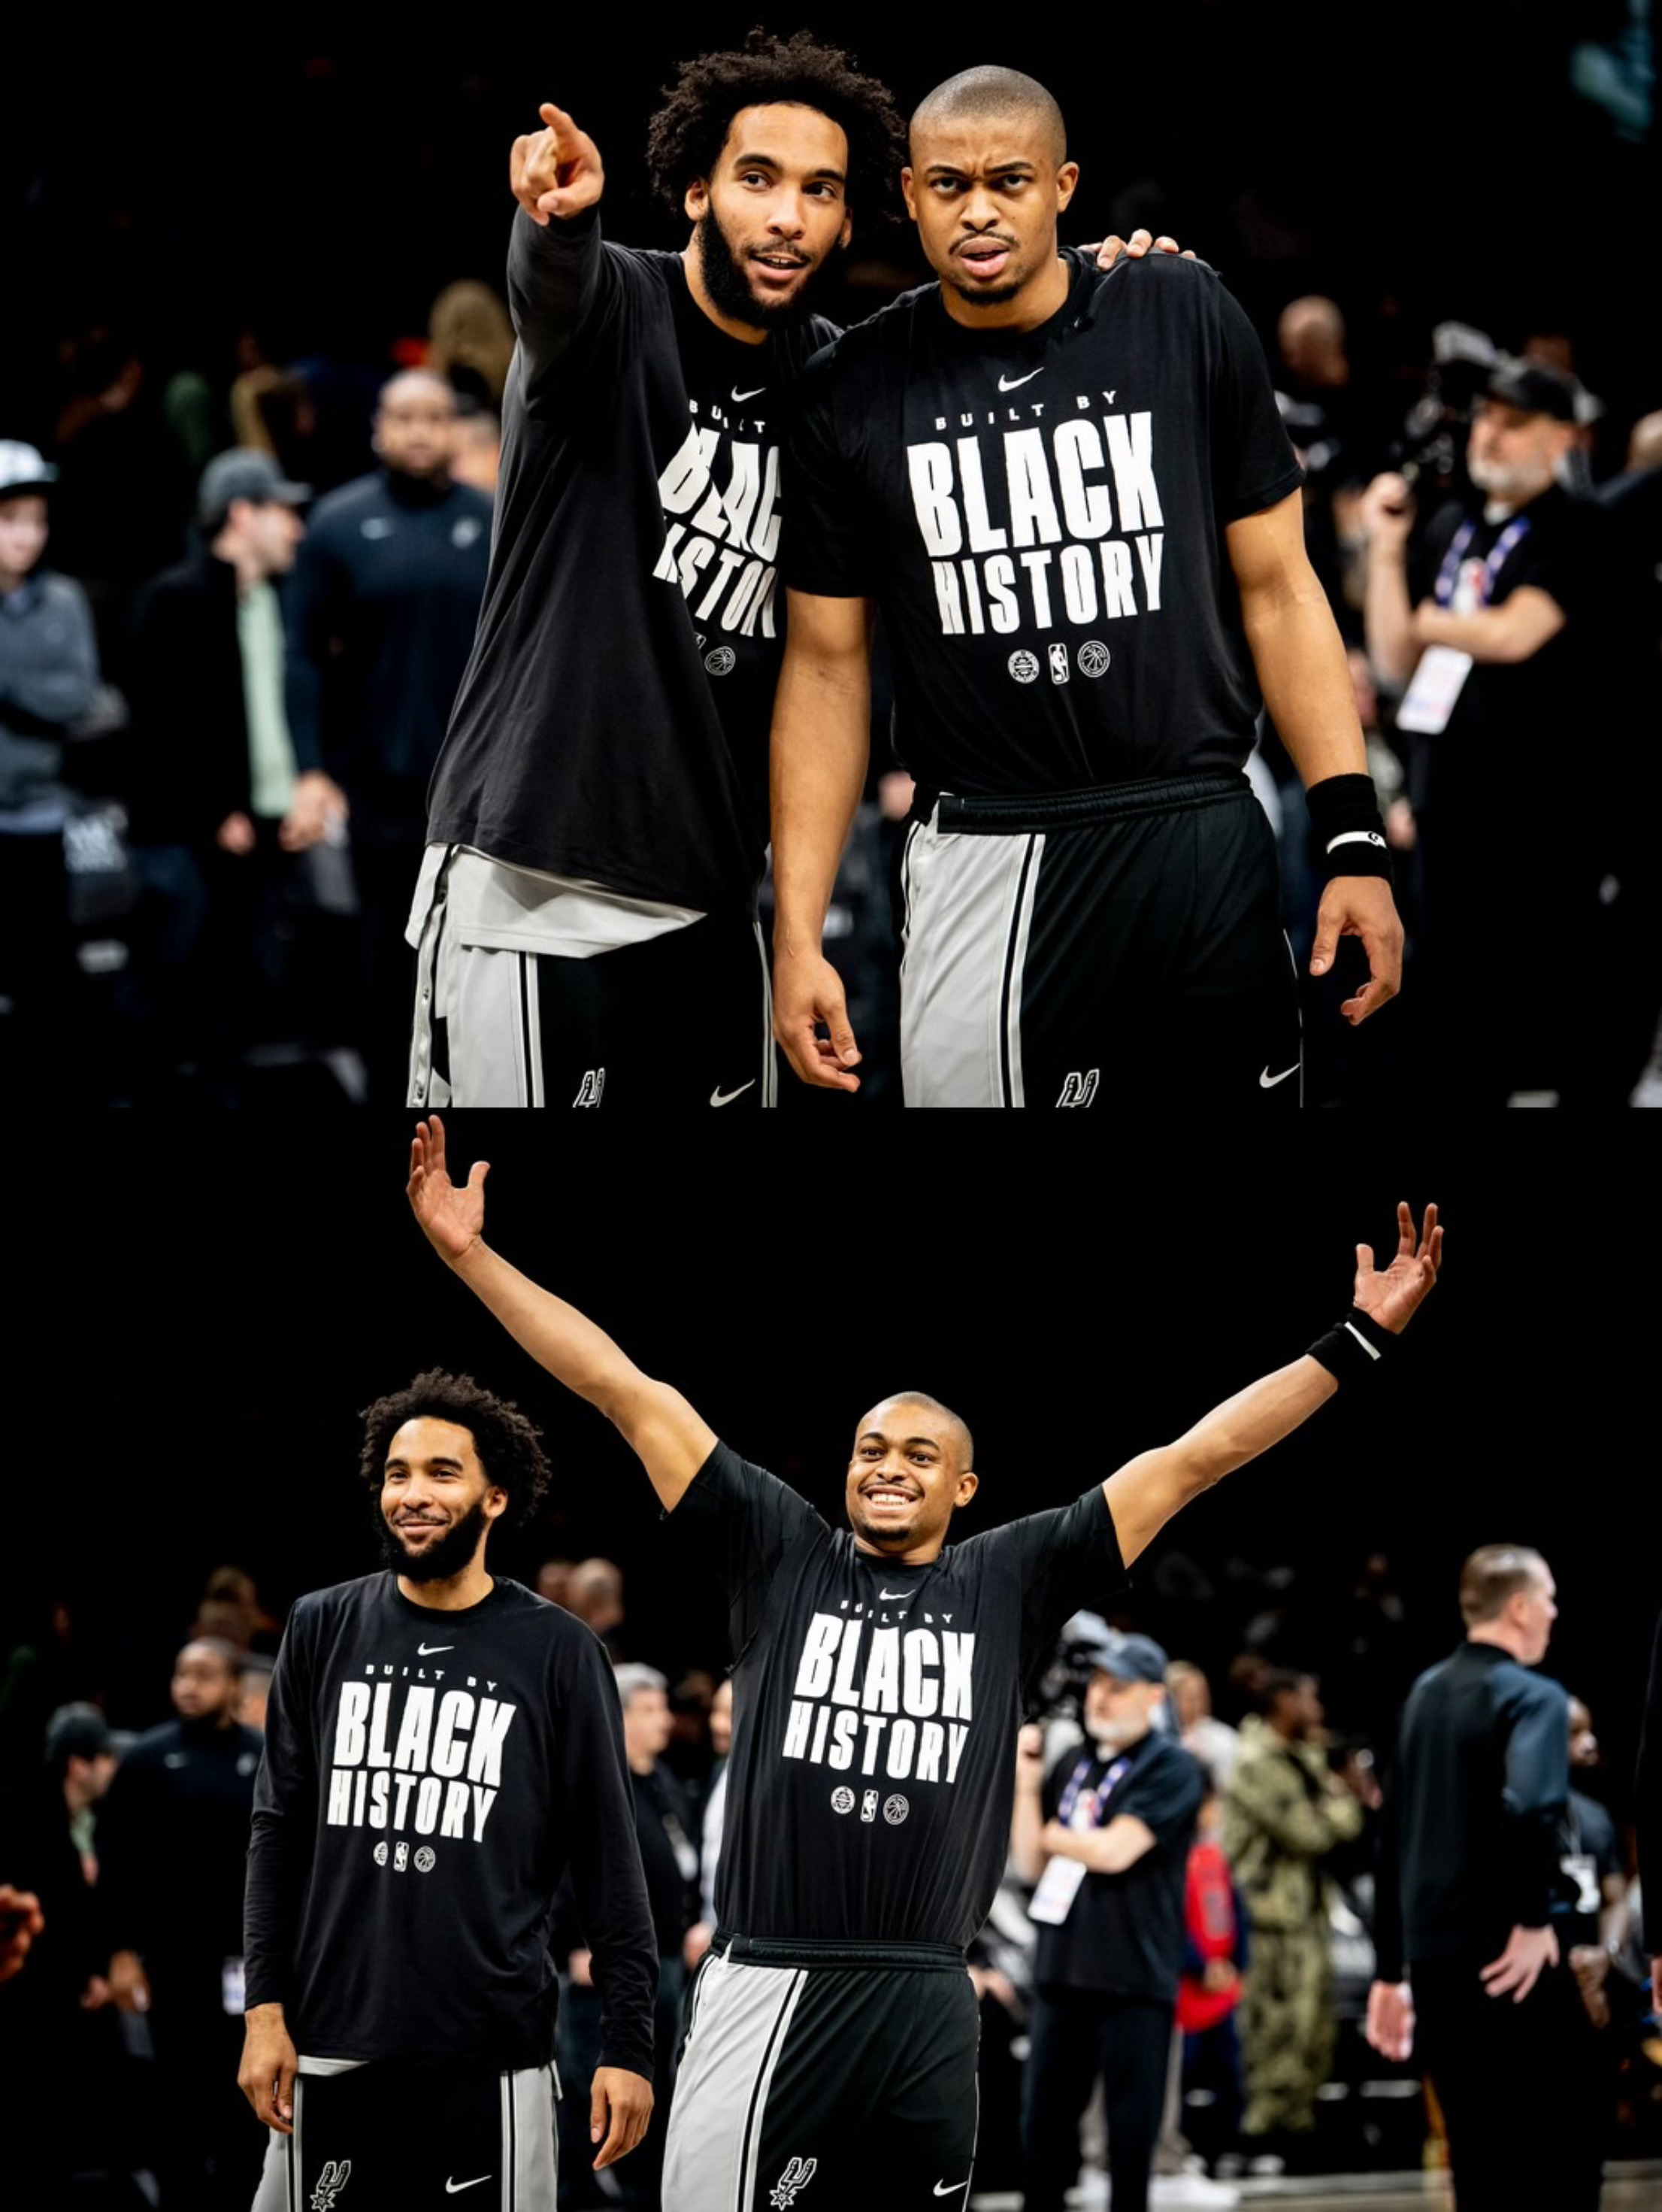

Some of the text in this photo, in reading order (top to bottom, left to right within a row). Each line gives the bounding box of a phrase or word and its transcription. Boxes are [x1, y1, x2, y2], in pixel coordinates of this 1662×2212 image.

[934, 390, 1116, 431] BUILT BY
[657, 421, 782, 562] BLAC
[907, 411, 1164, 557] BLACK
[931, 533, 1164, 635] HISTORY
[840, 1599, 952, 1624] BUILT BY
[365, 1664, 498, 1692] BUILT BY
[794, 1611, 976, 1722] BLACK
[333, 1681, 517, 1788] BLACK
[782, 1699, 970, 1784] HISTORY
[326, 1768, 498, 1843] HISTORY
